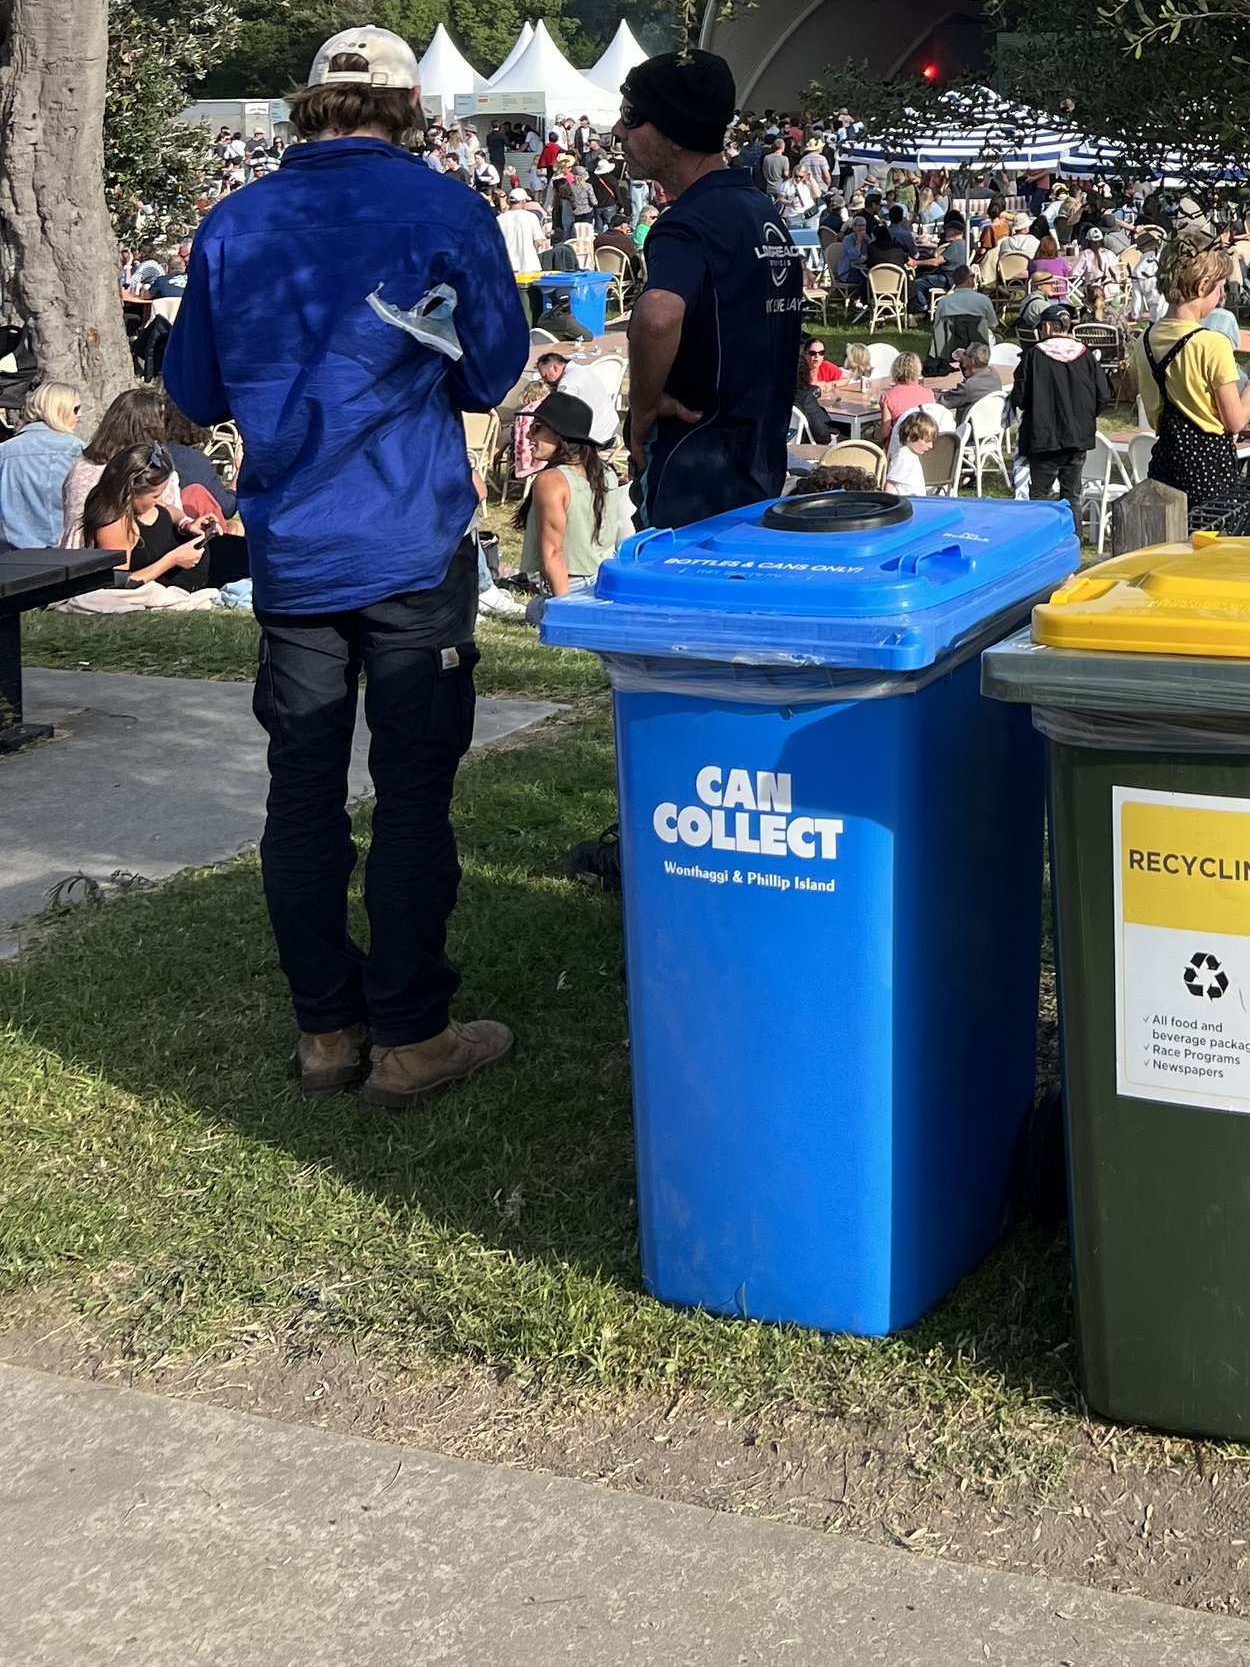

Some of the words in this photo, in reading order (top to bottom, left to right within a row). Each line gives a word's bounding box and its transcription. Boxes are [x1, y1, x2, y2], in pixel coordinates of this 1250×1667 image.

[663, 557, 738, 567] BOTTLES
[740, 560, 755, 568] &
[757, 561, 809, 571] CANS
[810, 564, 865, 573] ONLY!
[696, 765, 792, 813] CAN
[653, 802, 844, 859] COLLECT
[663, 860, 729, 883] Wonthaggi
[732, 869, 743, 883] &
[747, 871, 791, 891] Phillip
[794, 876, 836, 892] Island
[1152, 1014, 1168, 1026] All
[1171, 1016, 1198, 1030] food
[1201, 1022, 1223, 1033] and
[1152, 1029, 1207, 1046] beverage
[1152, 1044, 1181, 1057] Race
[1184, 1048, 1241, 1065] Programs
[1153, 1059, 1224, 1078] Newspapers
